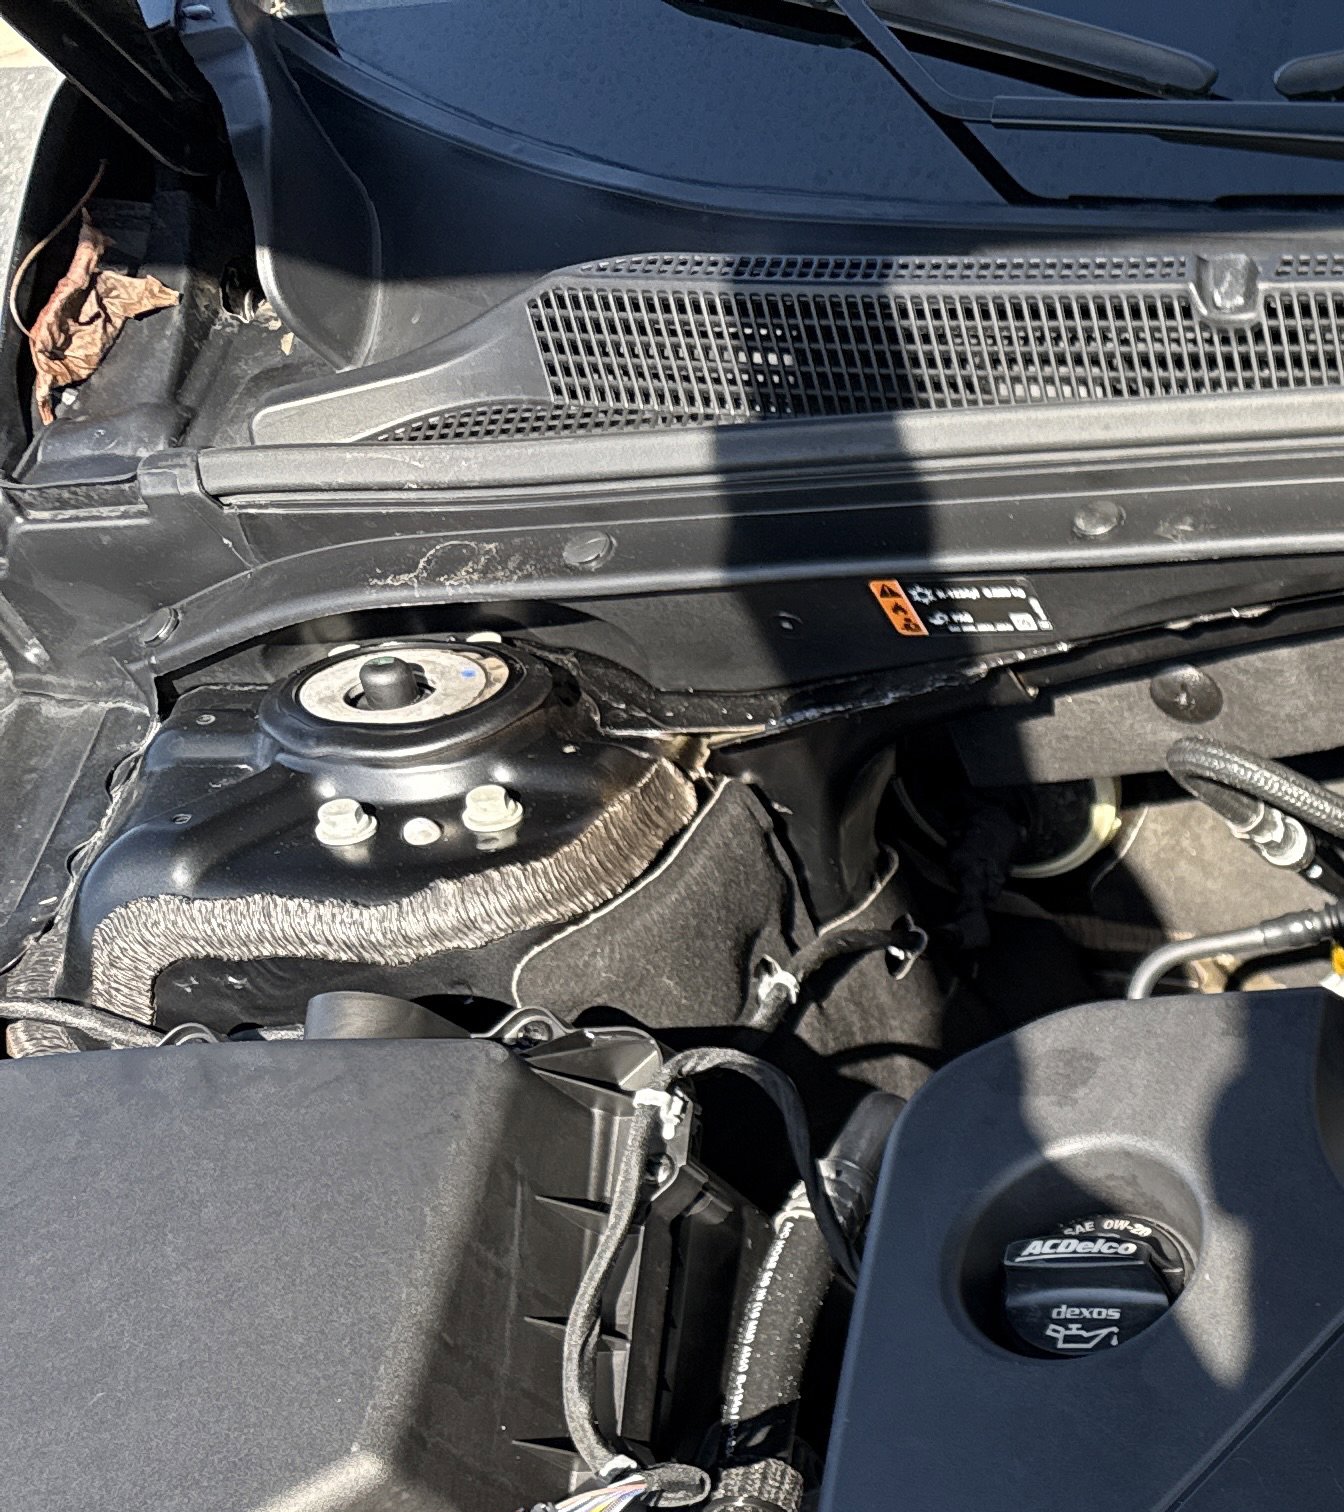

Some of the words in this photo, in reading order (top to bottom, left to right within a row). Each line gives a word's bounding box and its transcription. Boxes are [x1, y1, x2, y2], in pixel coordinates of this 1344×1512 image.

[1064, 1220, 1095, 1236] SAE
[1020, 1238, 1138, 1256] ACDelco
[1052, 1304, 1121, 1320] dexos
